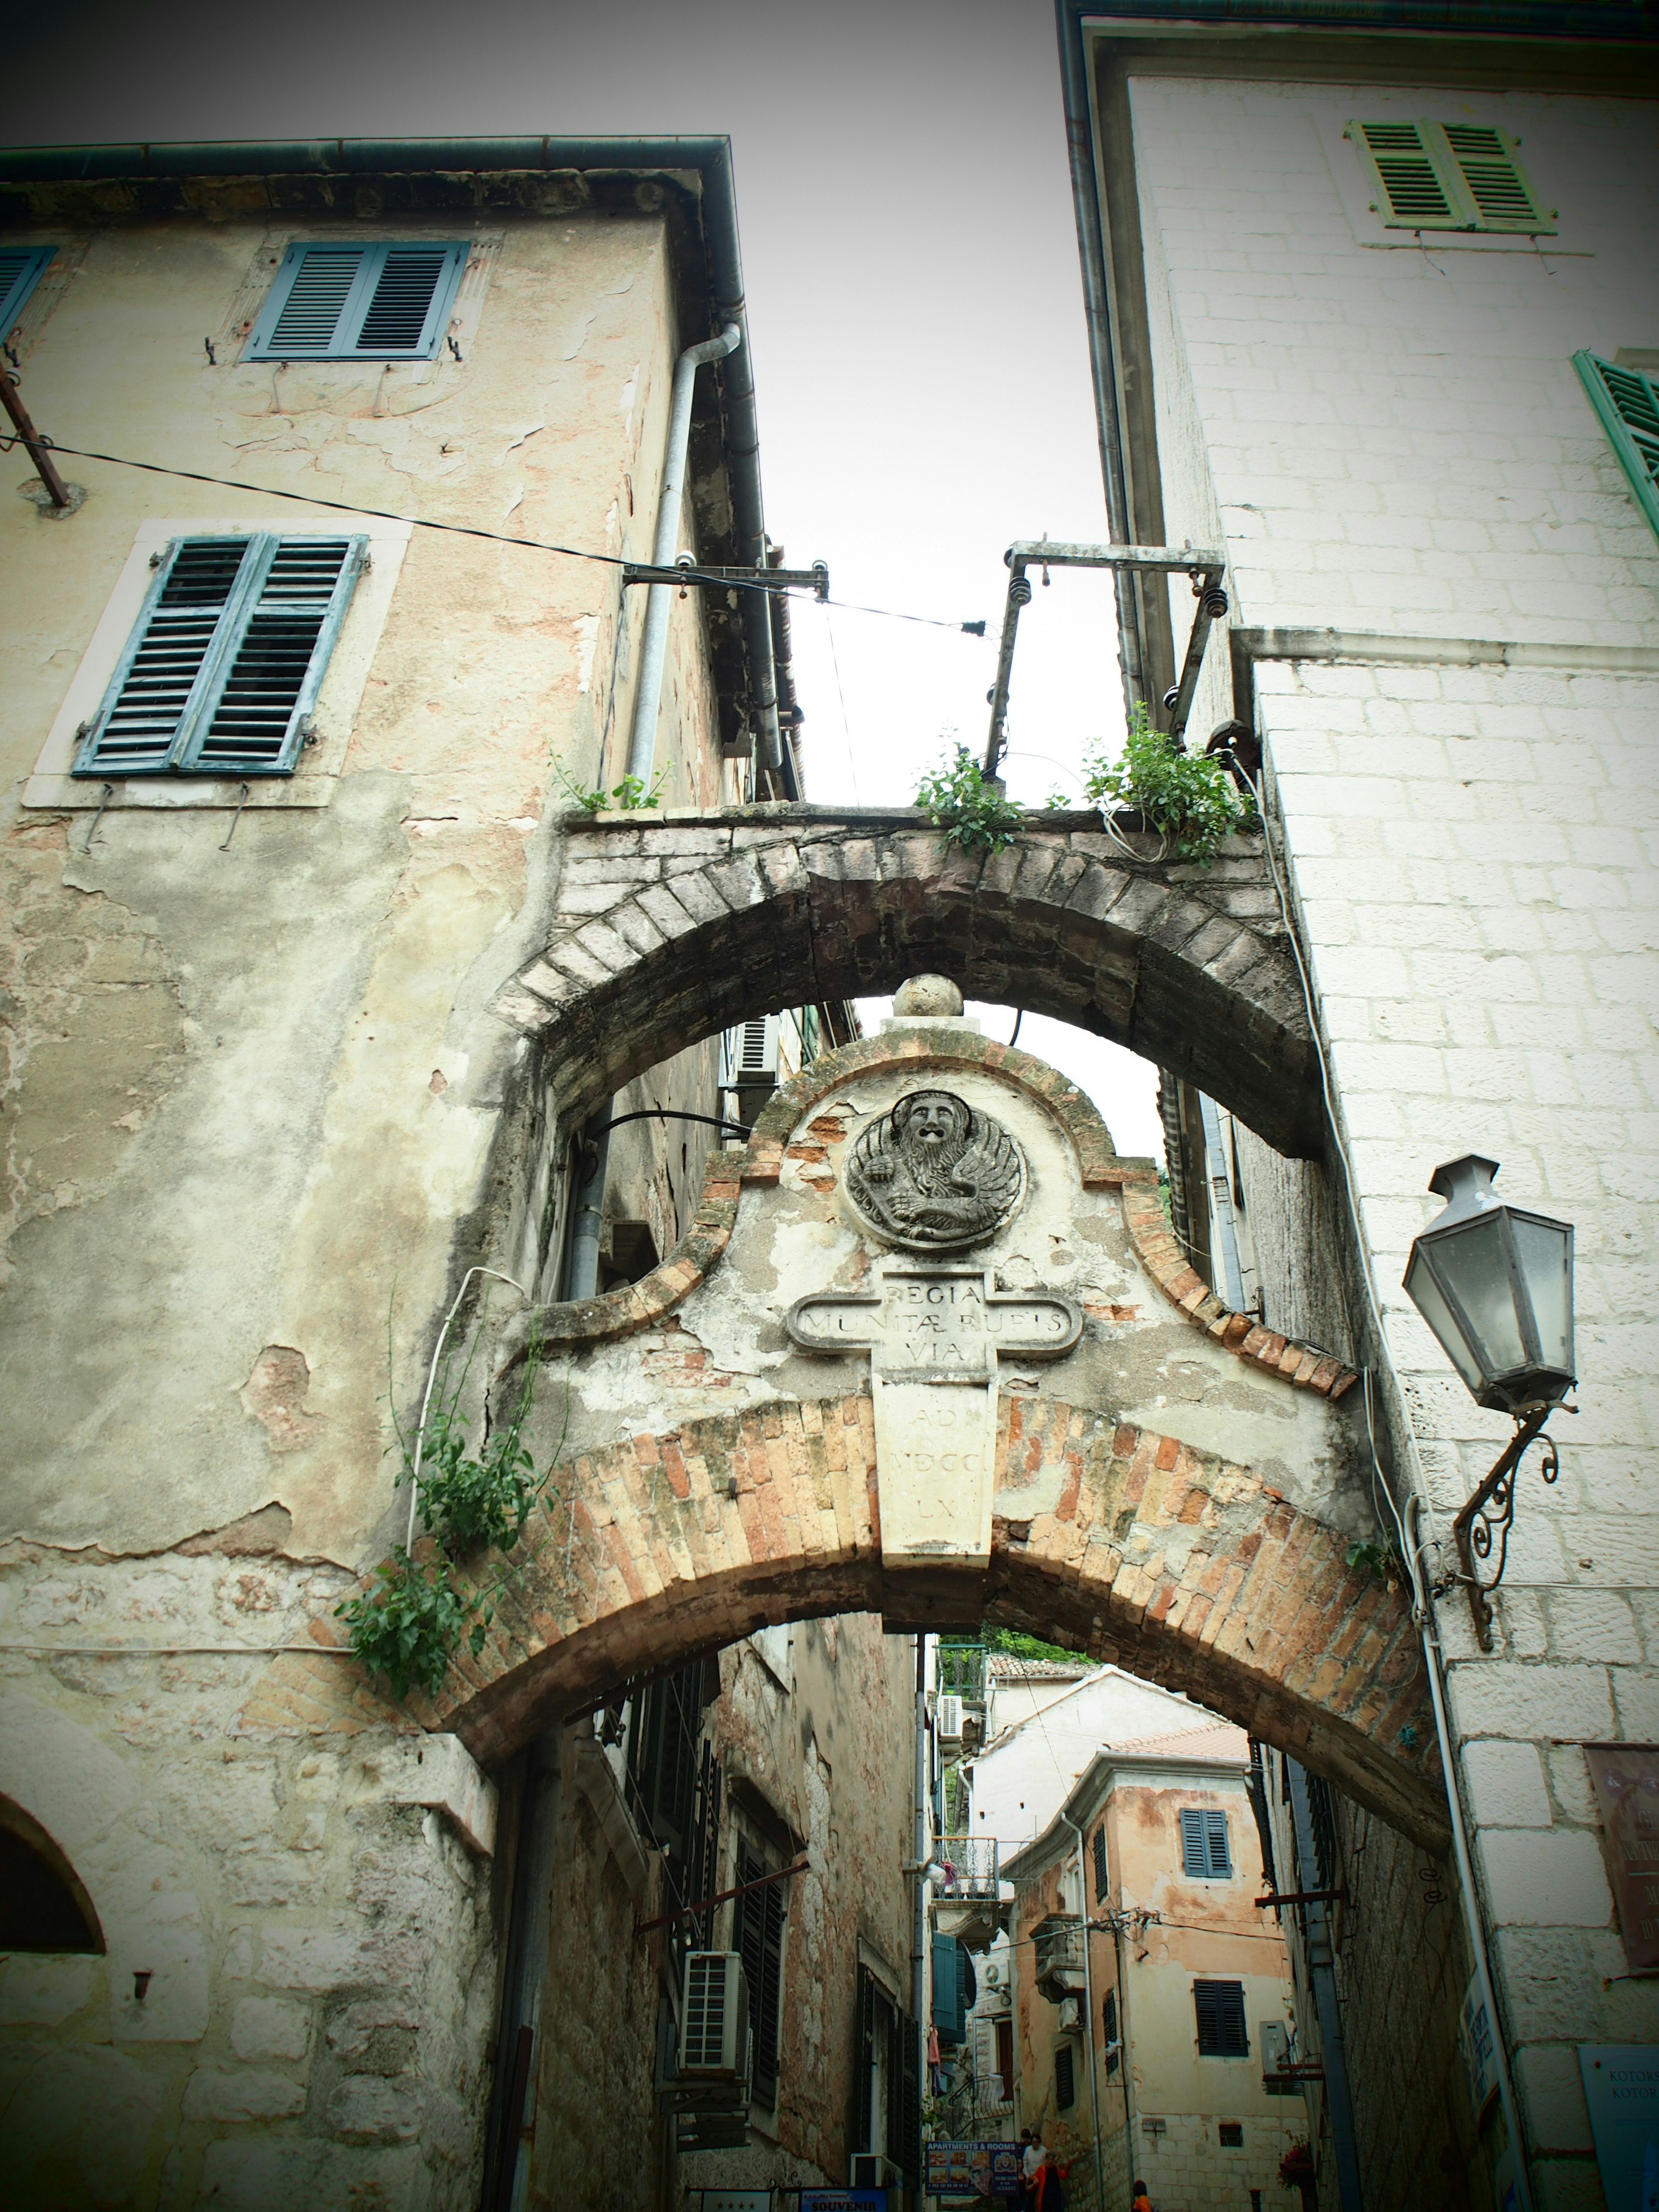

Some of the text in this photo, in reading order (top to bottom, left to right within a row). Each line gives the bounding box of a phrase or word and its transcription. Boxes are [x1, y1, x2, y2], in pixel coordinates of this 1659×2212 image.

[886, 1286, 981, 1304] REGIA
[905, 1343, 964, 1361] VIA
[917, 1500, 955, 1519] LX
[811, 2201, 877, 2212] SOUVENIR
